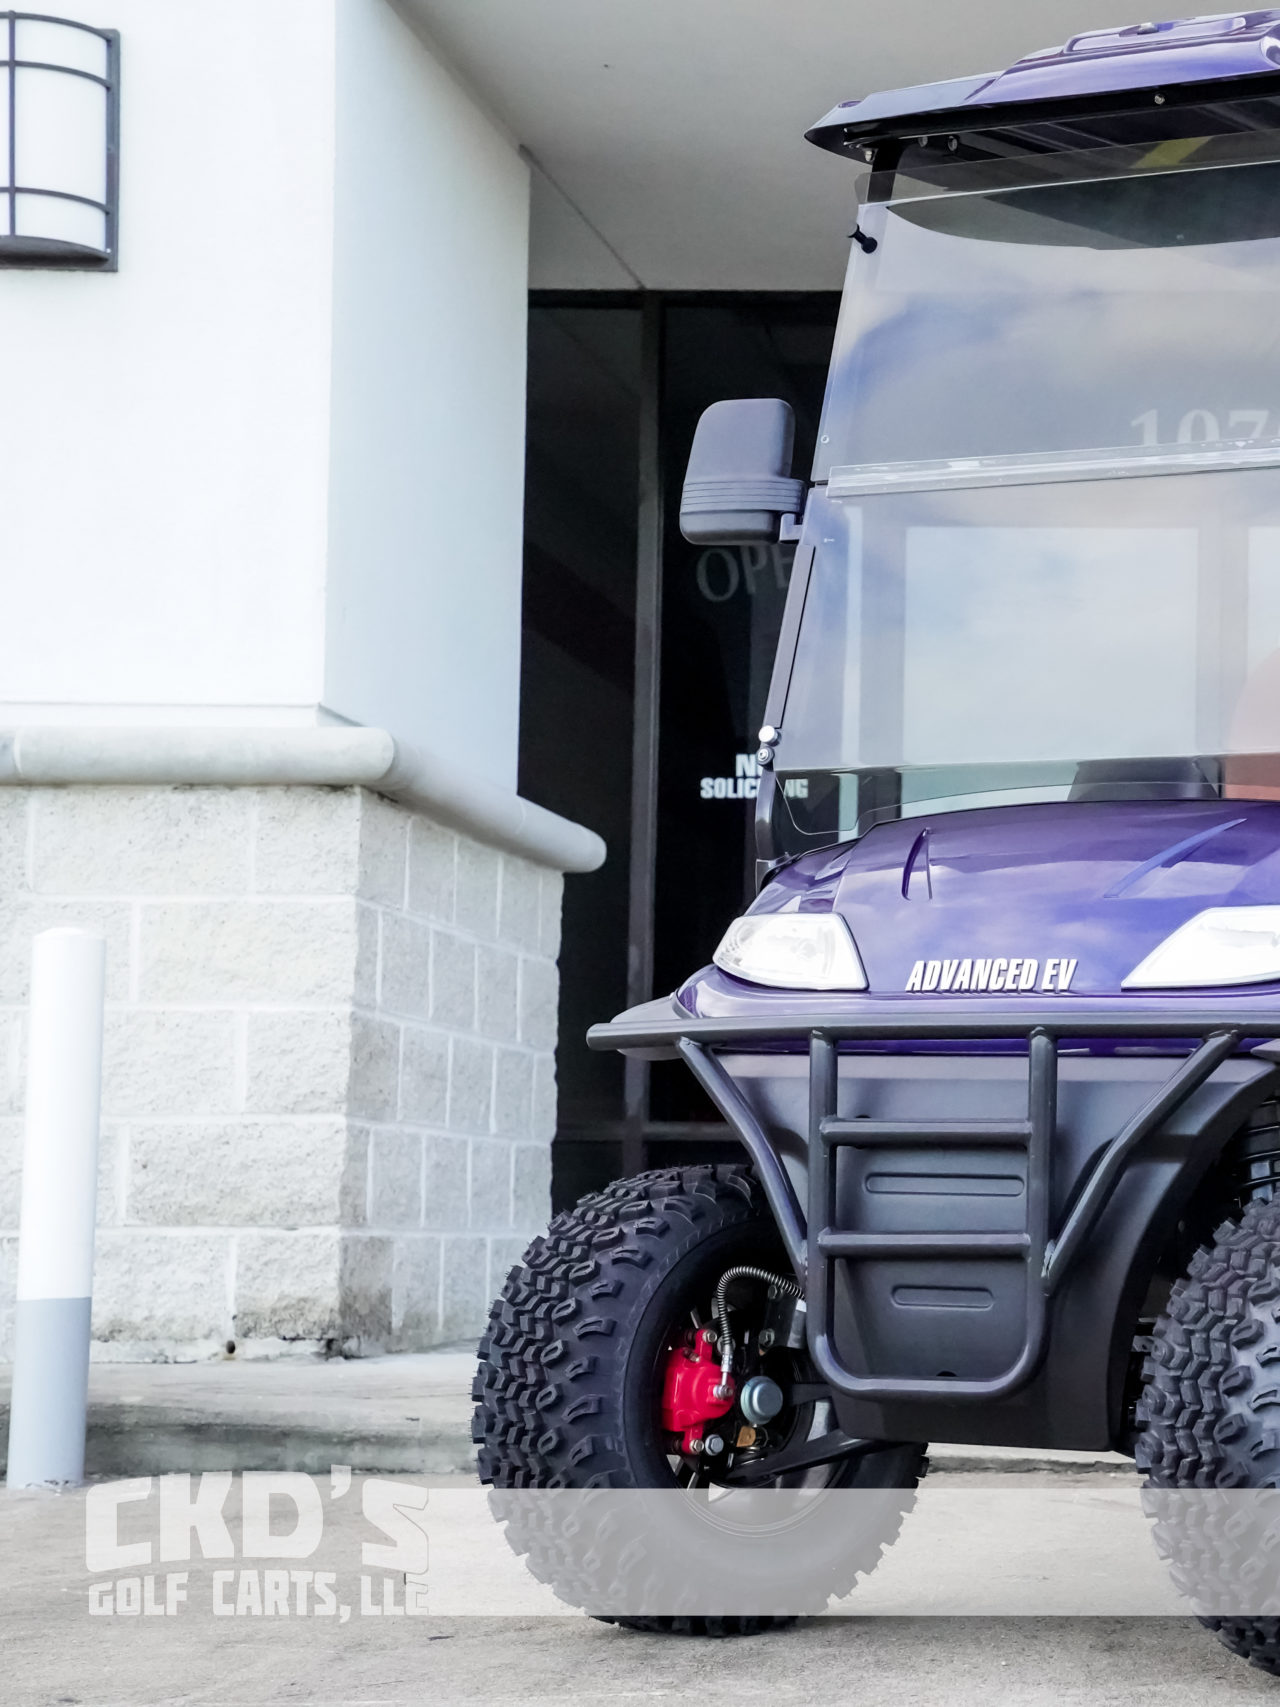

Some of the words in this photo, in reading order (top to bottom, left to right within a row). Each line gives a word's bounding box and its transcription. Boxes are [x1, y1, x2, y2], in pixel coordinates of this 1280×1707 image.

[697, 545, 797, 601] OPE
[700, 777, 809, 799] SOLICNG
[905, 958, 1039, 991] ADVANCED
[1041, 958, 1078, 990] EV
